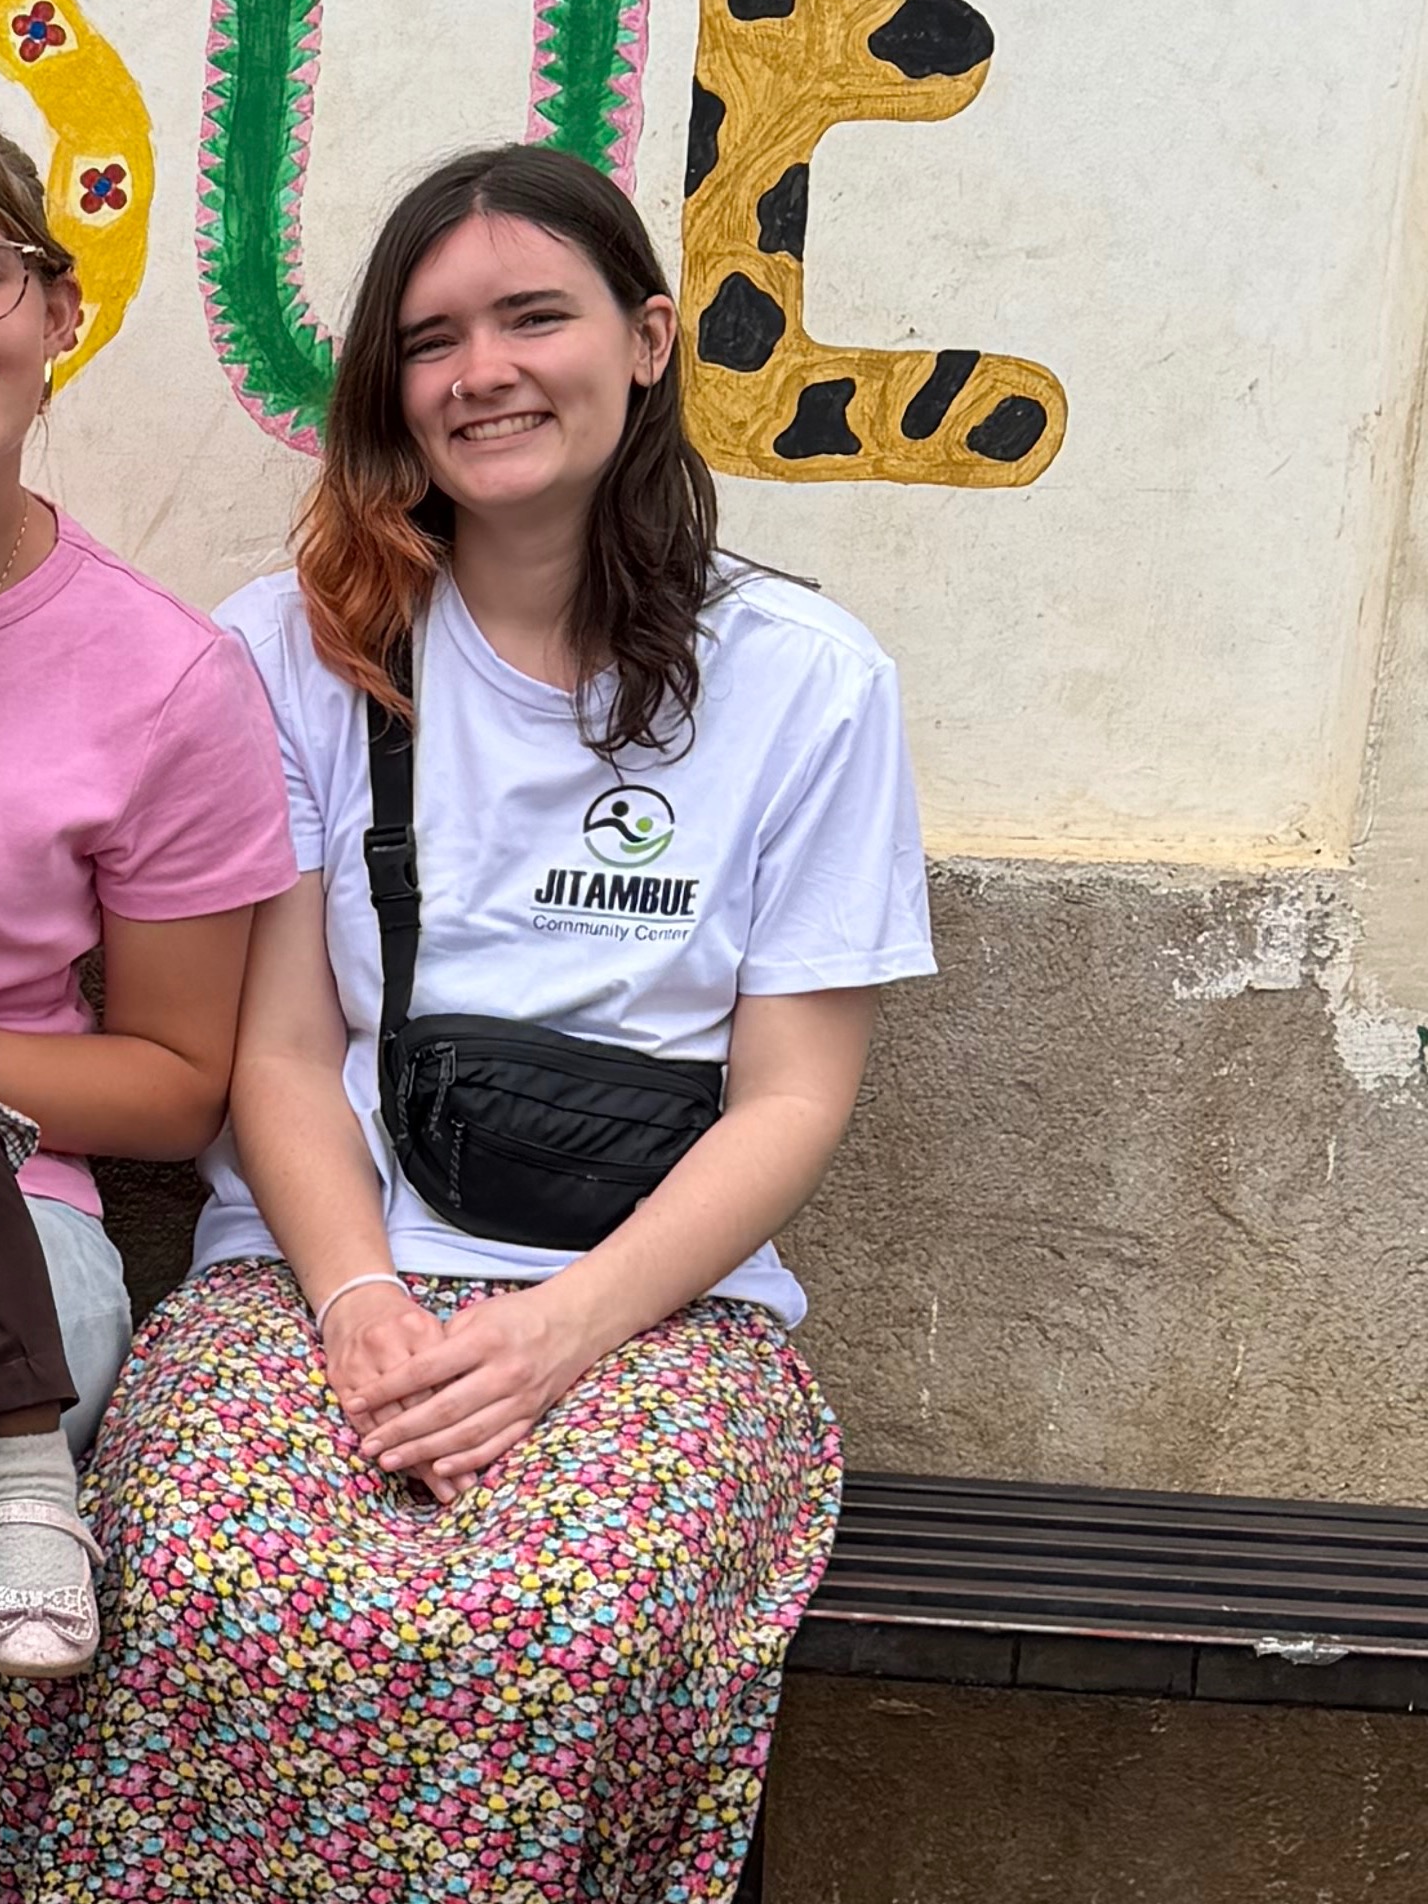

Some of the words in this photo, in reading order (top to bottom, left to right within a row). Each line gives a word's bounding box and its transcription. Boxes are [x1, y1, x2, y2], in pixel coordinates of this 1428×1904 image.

[534, 869, 700, 916] JITAMBUE
[532, 914, 630, 942] Community
[634, 924, 691, 942] Center
